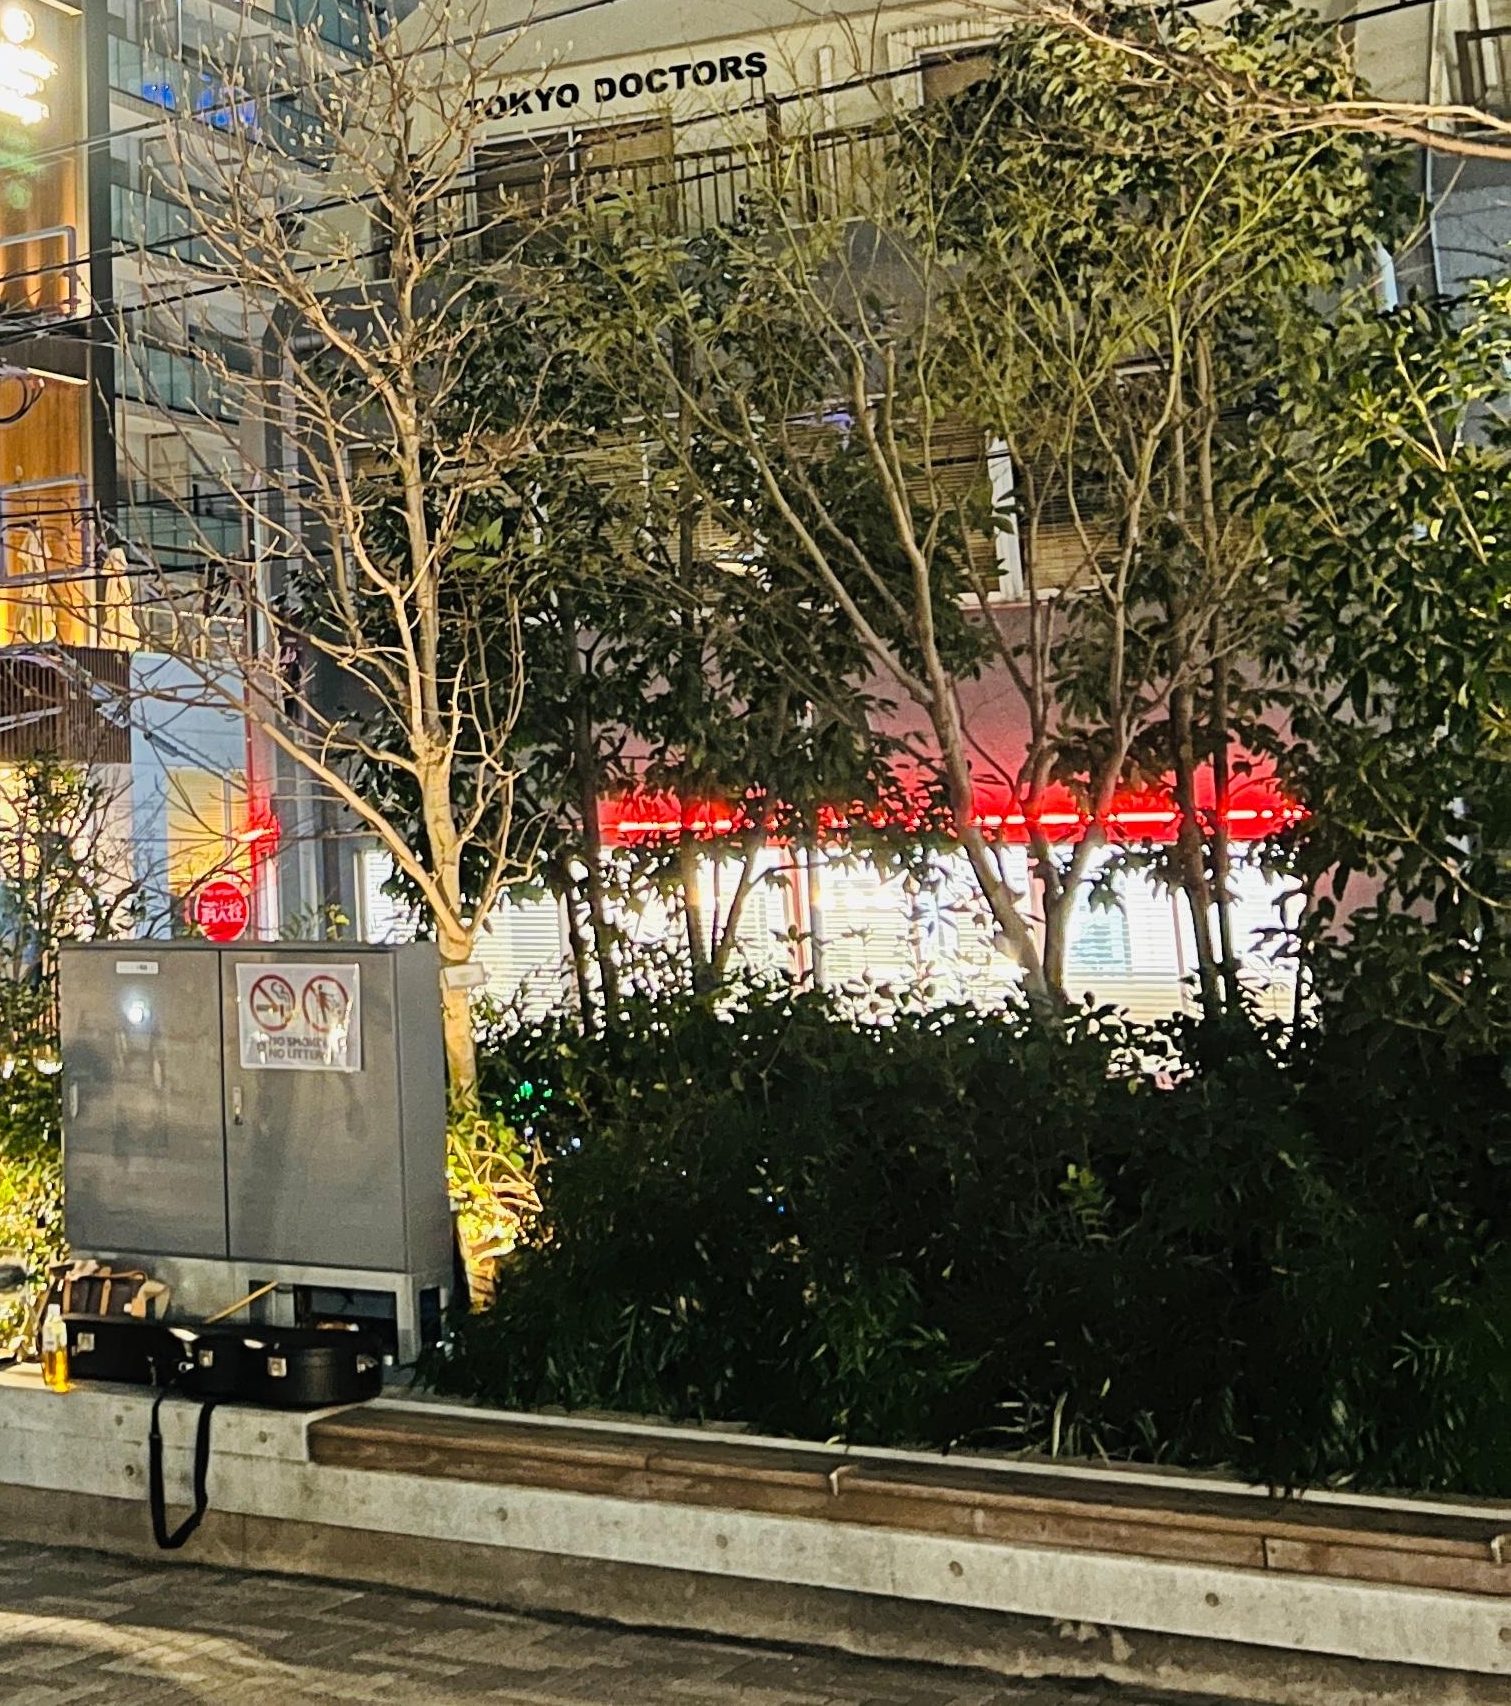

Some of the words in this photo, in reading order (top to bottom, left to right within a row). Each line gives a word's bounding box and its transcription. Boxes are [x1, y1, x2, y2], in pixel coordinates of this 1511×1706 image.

[464, 83, 580, 120] TOKYO
[594, 51, 768, 103] DOCTORS
[268, 1048, 286, 1060] NO
